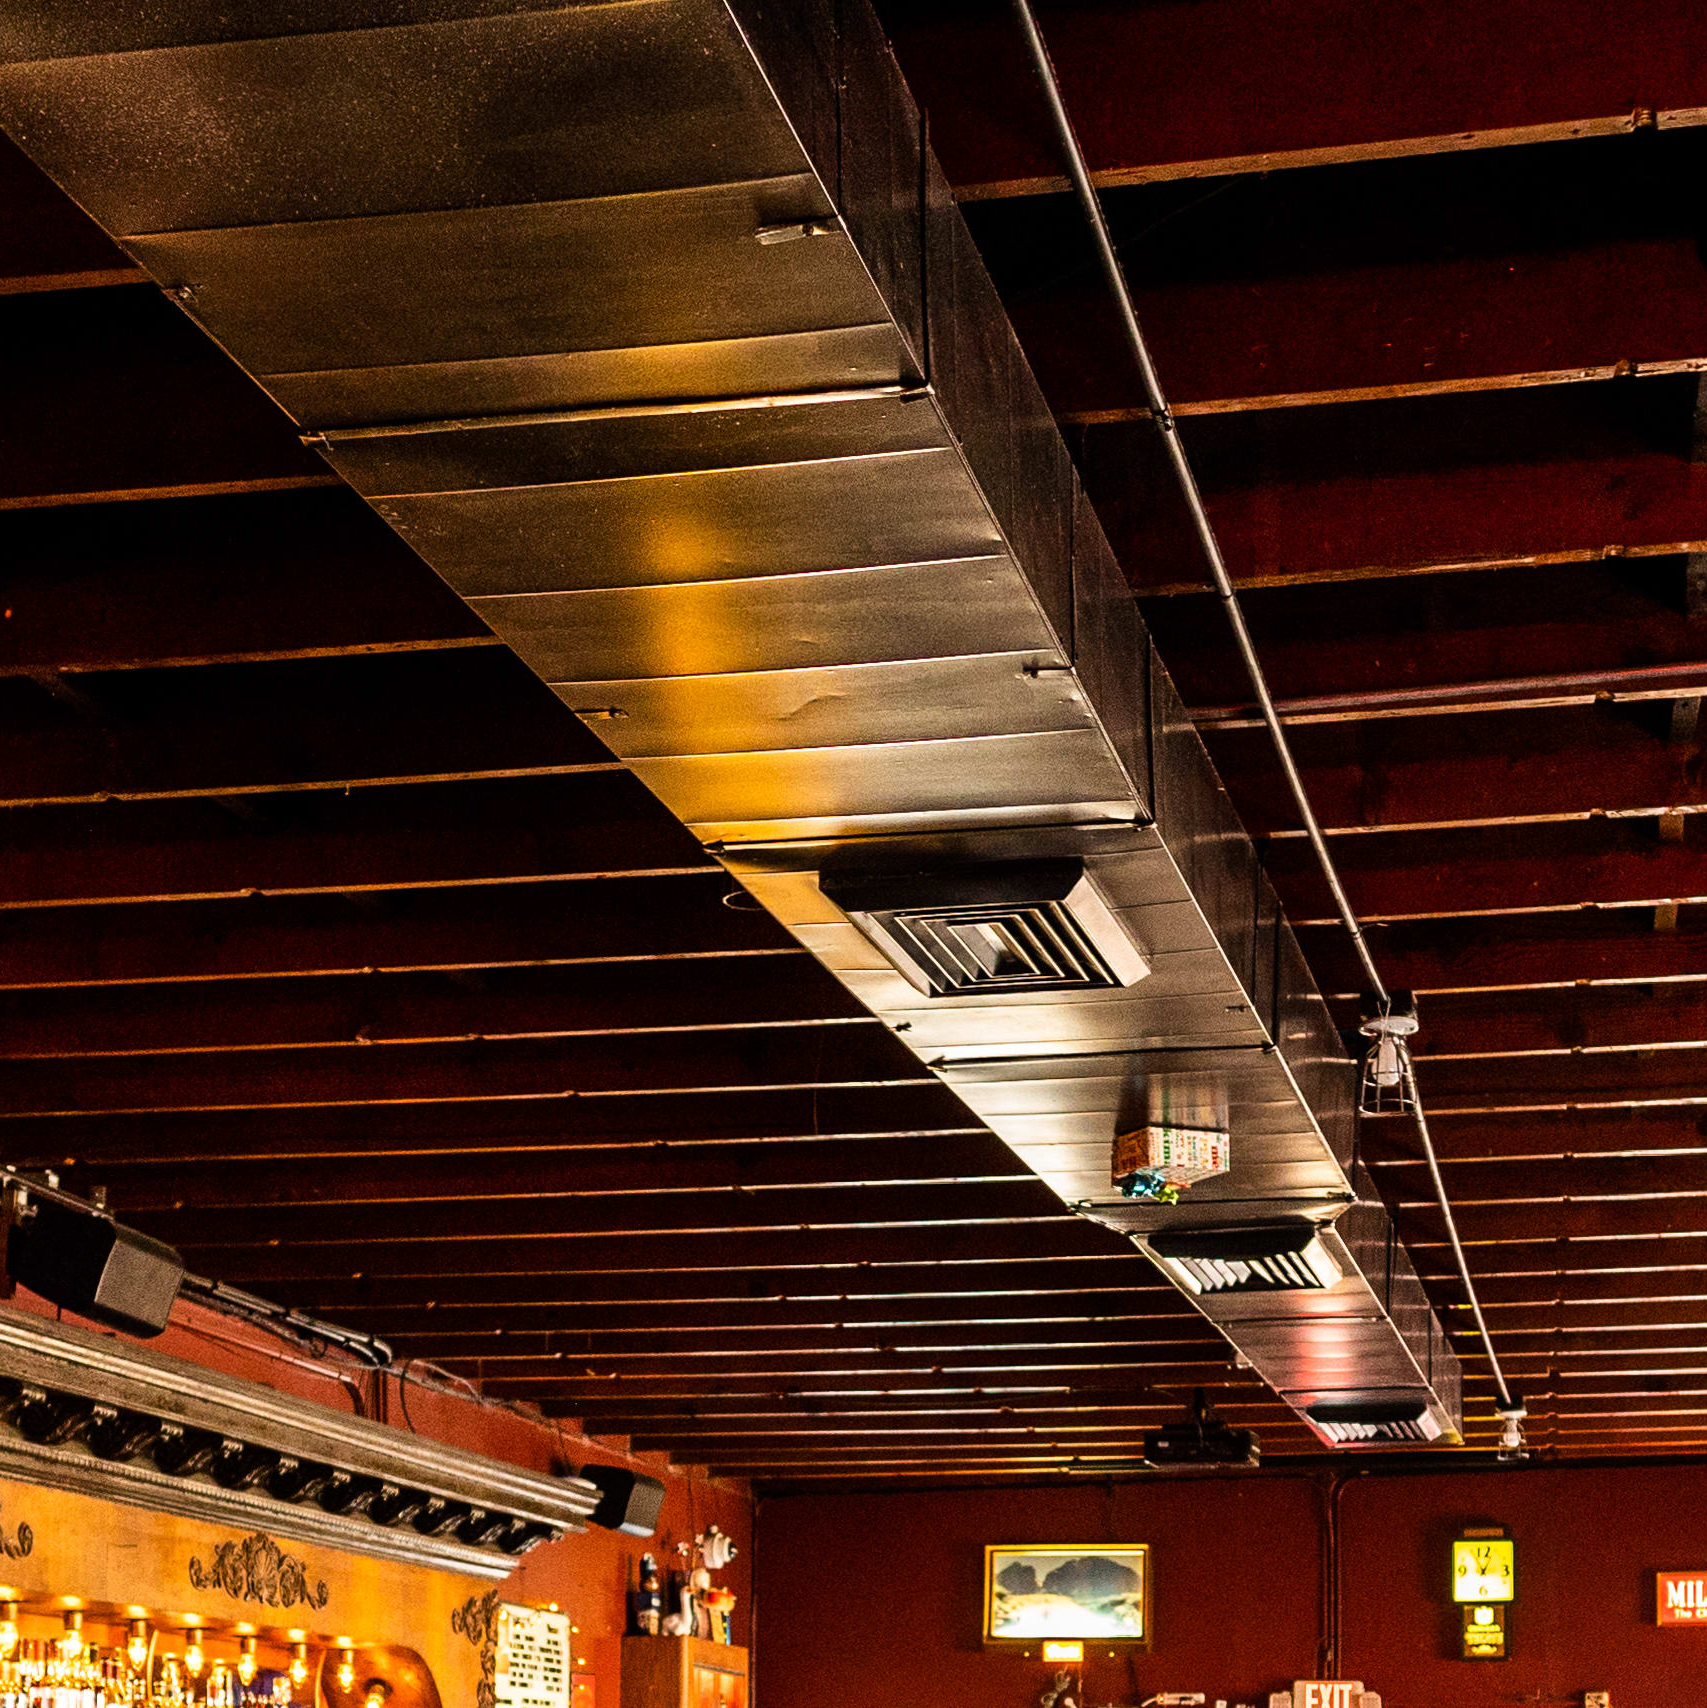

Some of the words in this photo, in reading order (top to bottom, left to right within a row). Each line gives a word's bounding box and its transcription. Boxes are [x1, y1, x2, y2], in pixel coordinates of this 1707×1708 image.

[1477, 1546, 1491, 1558] 12
[1458, 1564, 1467, 1578] 9
[1501, 1564, 1510, 1577] 3
[1478, 1585, 1488, 1597] 6
[1674, 1609, 1692, 1619] The
